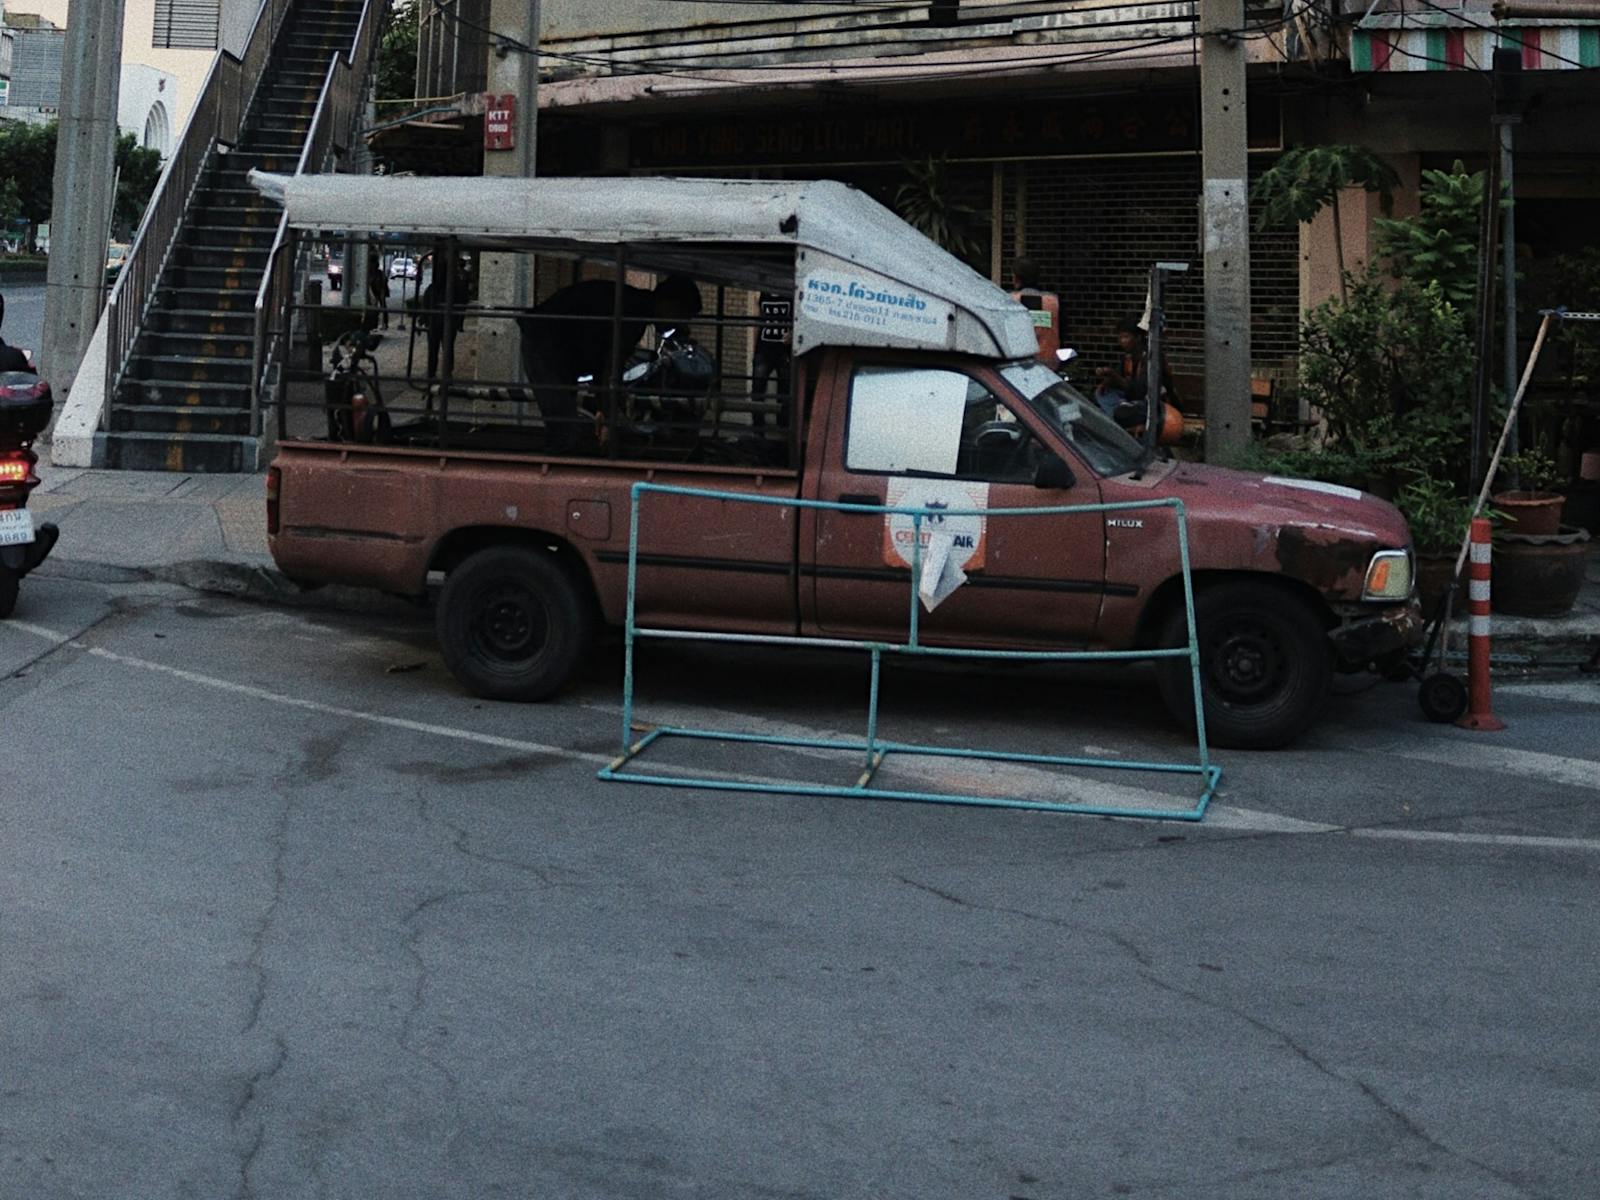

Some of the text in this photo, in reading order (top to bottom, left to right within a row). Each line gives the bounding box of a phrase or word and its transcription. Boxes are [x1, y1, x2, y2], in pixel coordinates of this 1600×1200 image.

[489, 110, 510, 121] KTT
[1107, 519, 1144, 528] HILUX
[952, 534, 974, 549] AIR
